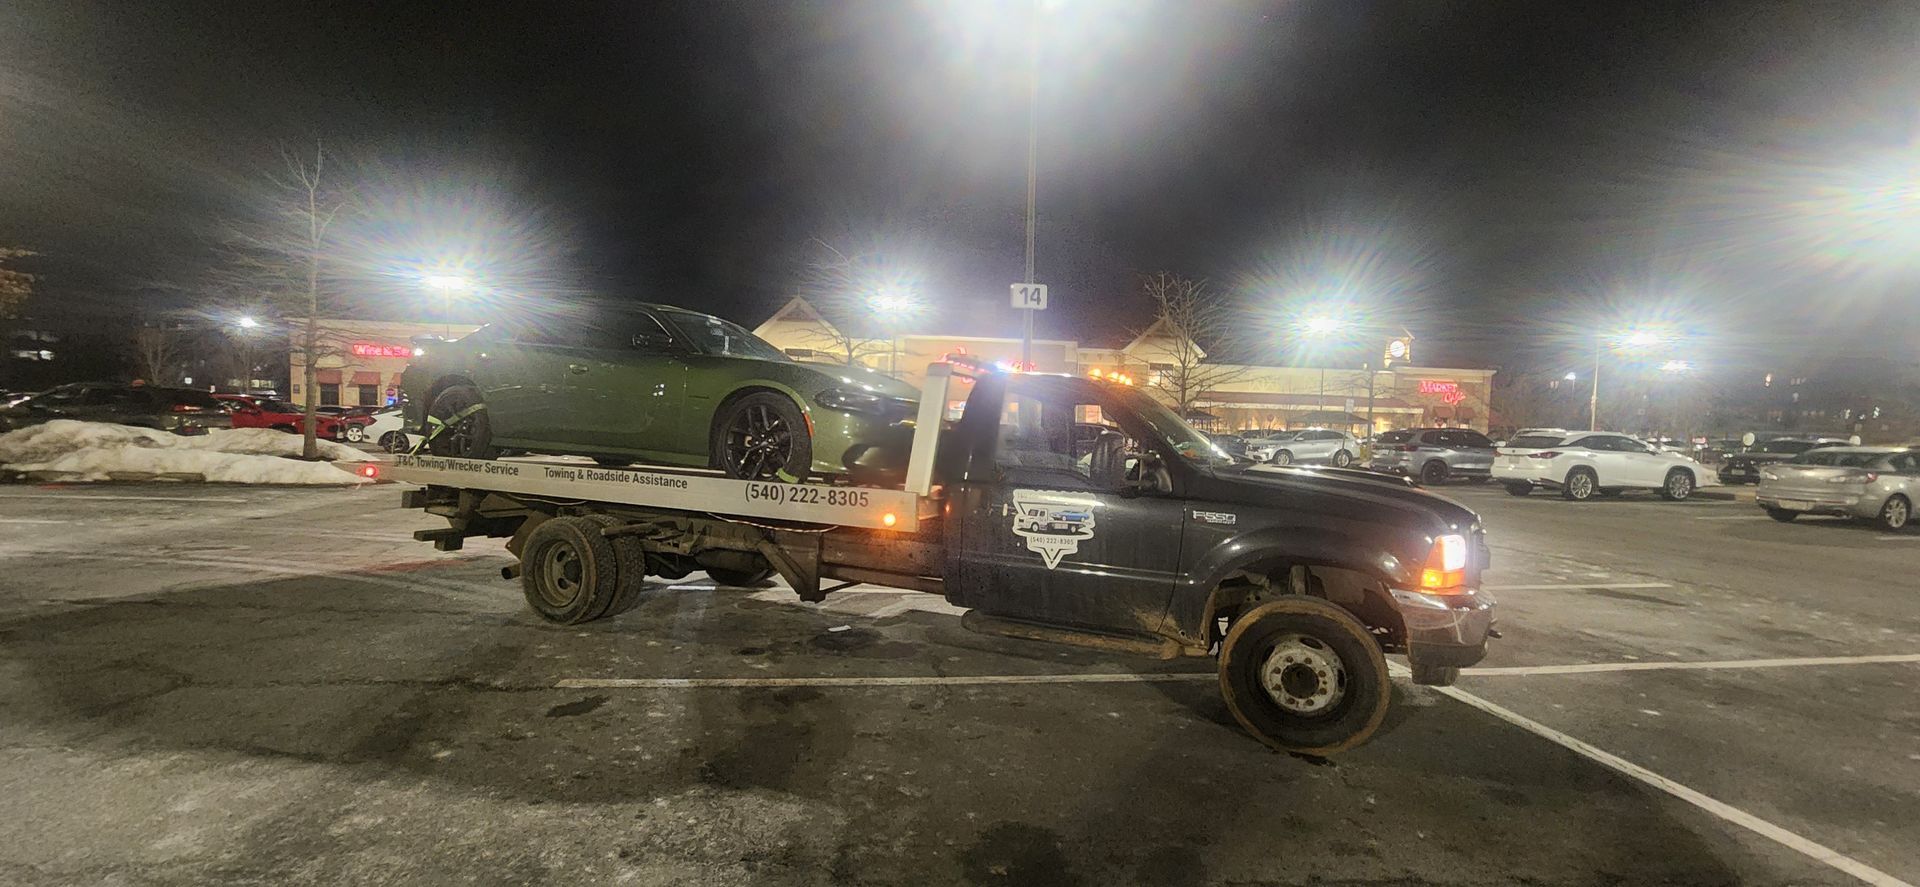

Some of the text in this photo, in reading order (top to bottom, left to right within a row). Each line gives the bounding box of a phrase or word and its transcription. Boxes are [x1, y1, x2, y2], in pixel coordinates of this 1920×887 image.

[1019, 286, 1042, 306] 14
[353, 344, 382, 355] Wine
[416, 456, 483, 473] Towing/Wrecker
[484, 462, 519, 476] Service
[544, 467, 688, 489] Towing & Roadside Assistance
[745, 482, 869, 508] (540) 222-8305
[1030, 536, 1074, 546] (540) 222-8305
